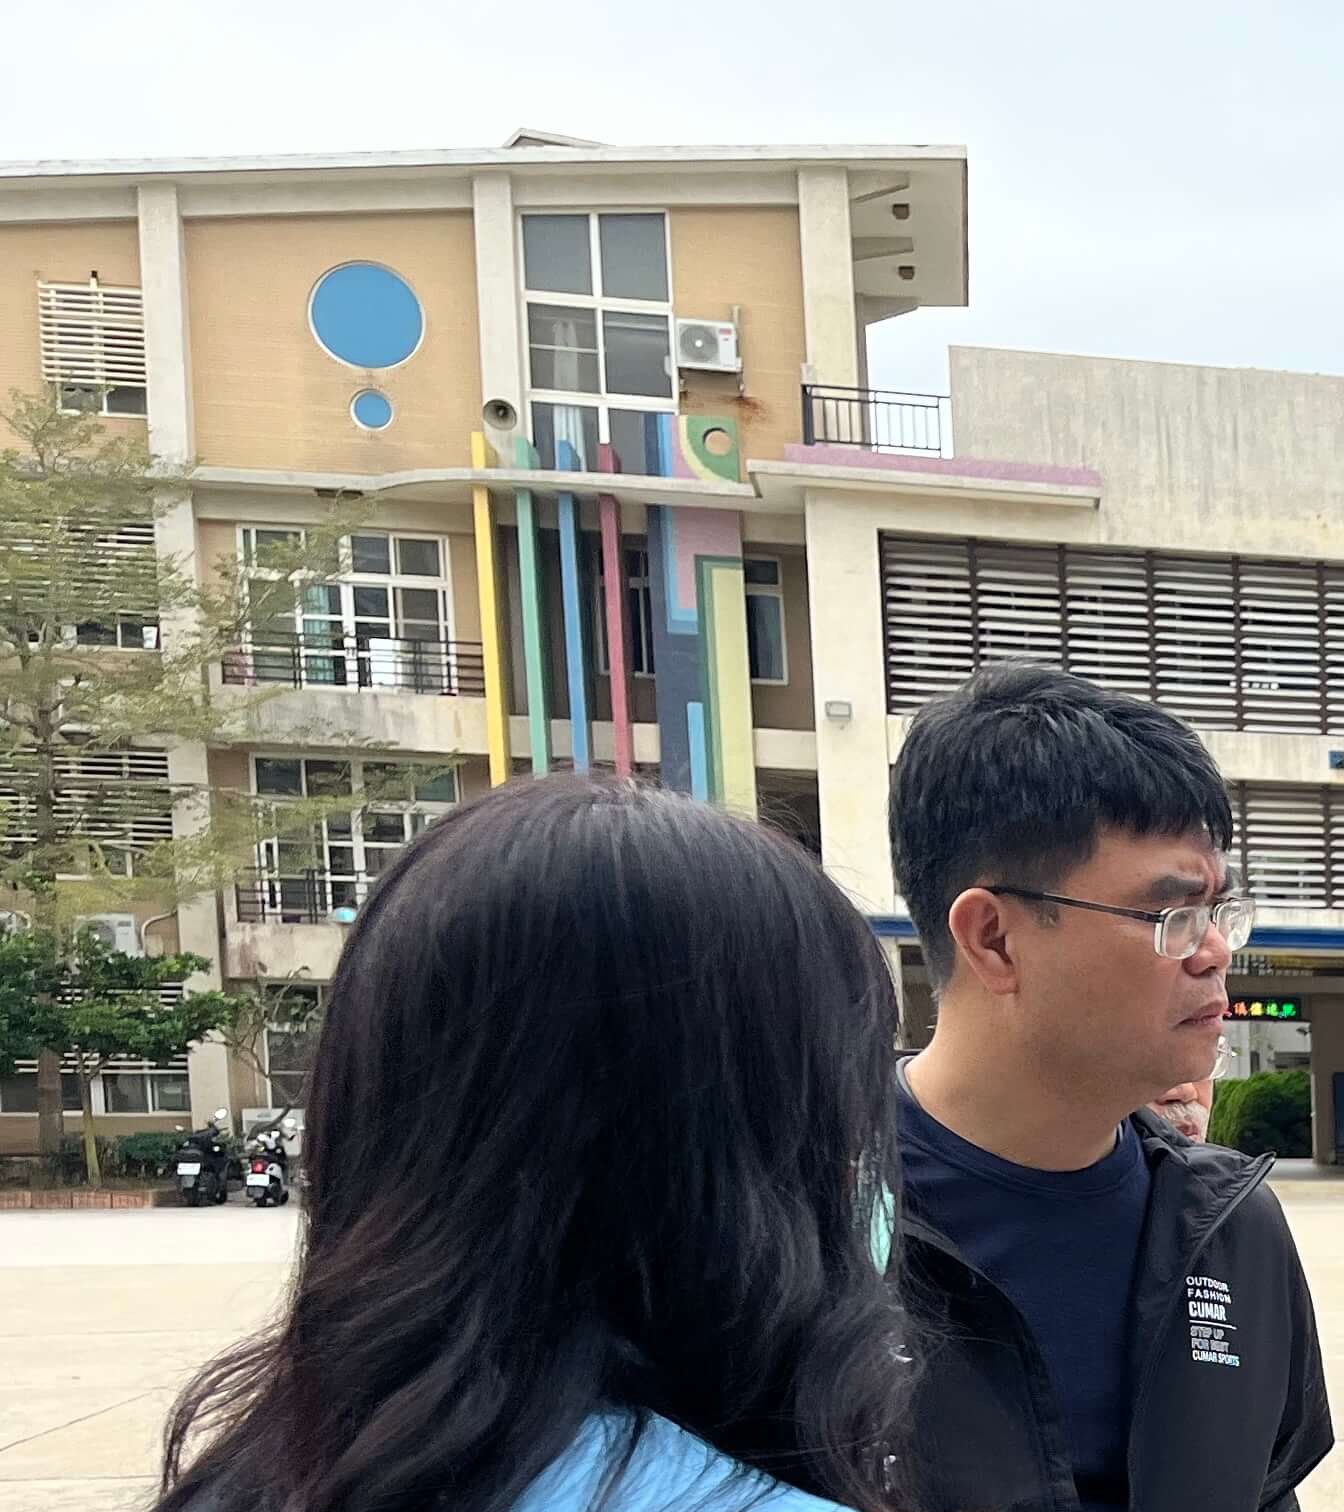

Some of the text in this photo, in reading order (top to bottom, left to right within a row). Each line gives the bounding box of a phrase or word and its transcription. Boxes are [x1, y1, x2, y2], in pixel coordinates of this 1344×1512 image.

[1186, 1276, 1229, 1291] OUTDOOR
[1187, 1288, 1231, 1303] FASHION
[1188, 1301, 1226, 1320] CUMAR
